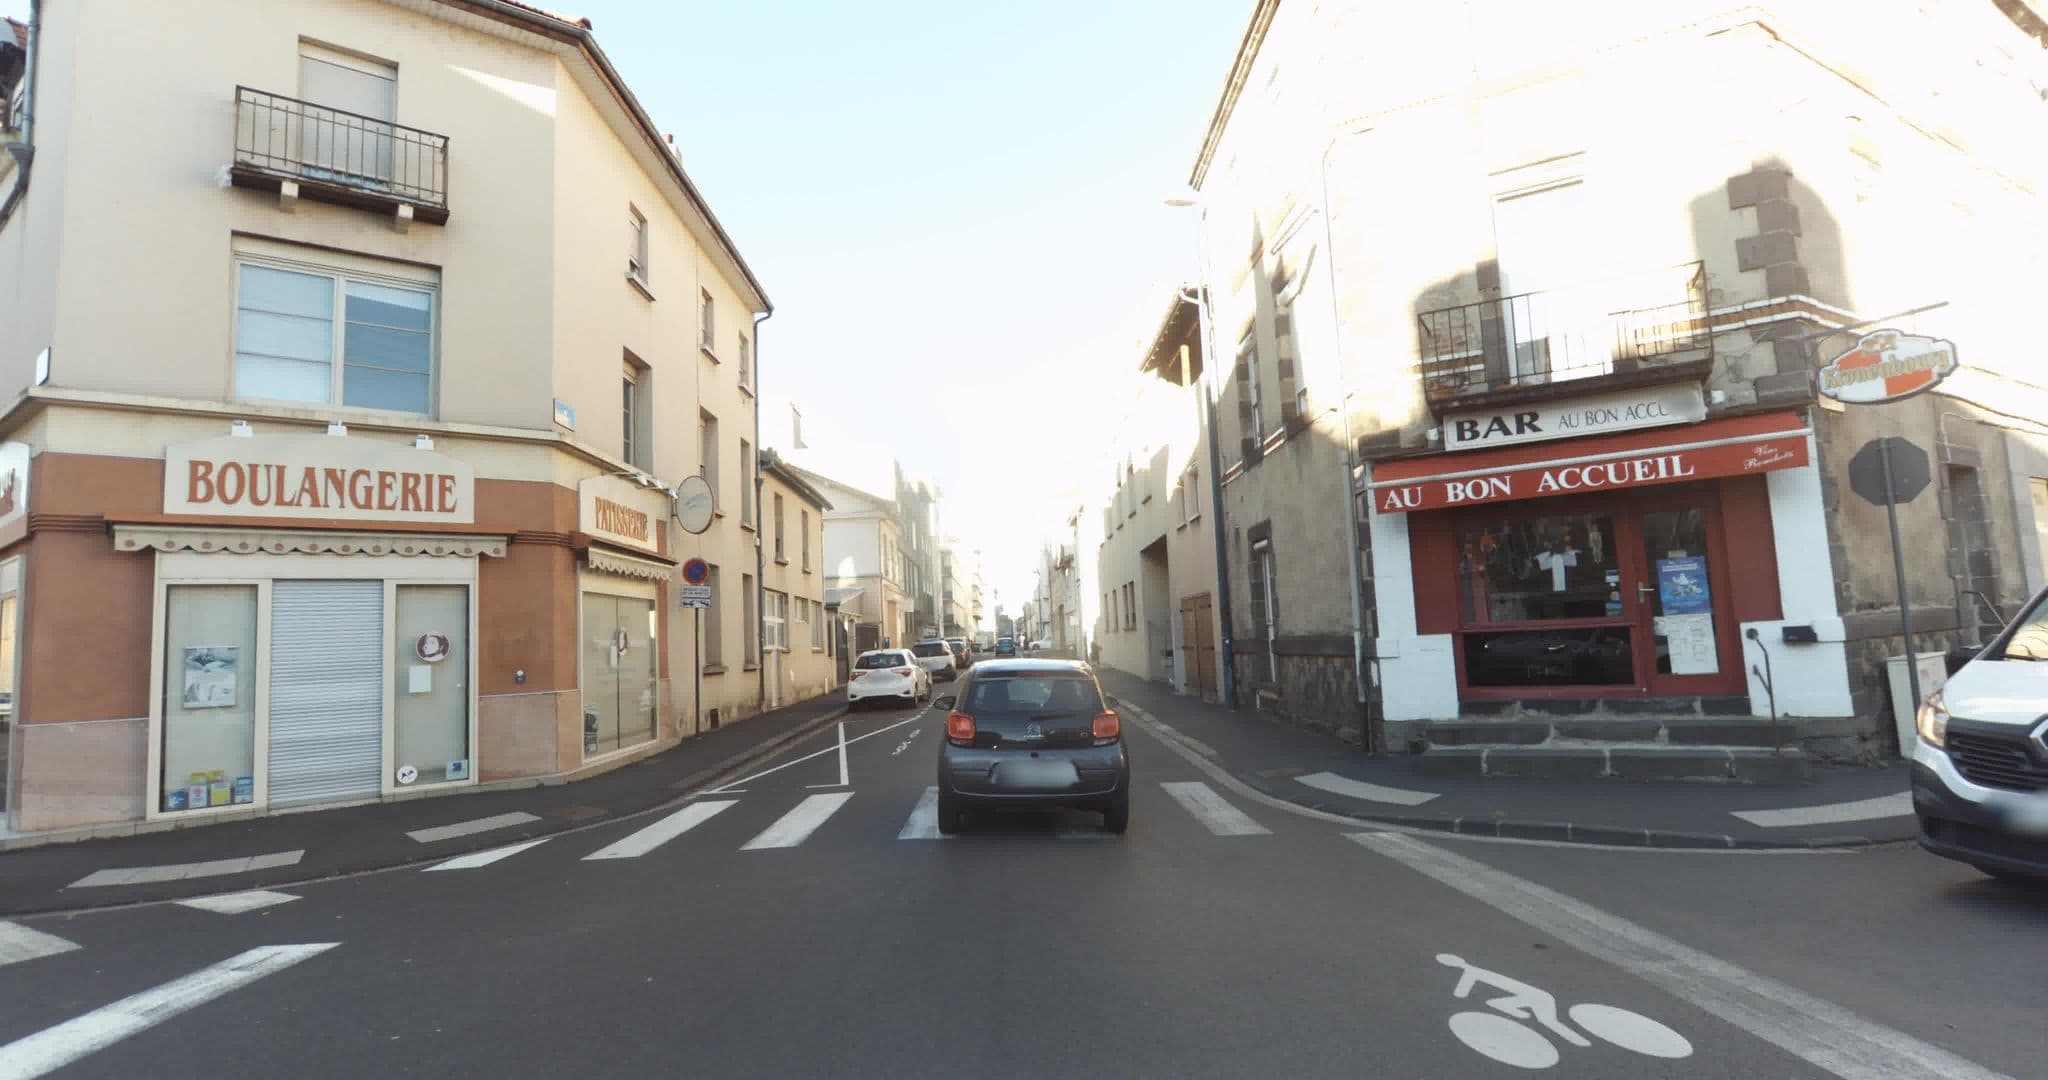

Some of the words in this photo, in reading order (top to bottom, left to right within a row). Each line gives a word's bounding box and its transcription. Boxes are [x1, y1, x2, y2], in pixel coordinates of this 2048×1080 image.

[1455, 411, 1543, 443] BAR
[1558, 413, 1580, 430] AU
[1584, 407, 1619, 426] BON
[187, 460, 457, 513] BOULANGERIE
[1384, 486, 1423, 510] AU
[1446, 476, 1512, 503] BON
[1538, 454, 1695, 493] ACCUEIL
[595, 496, 649, 543] PATISSERIE
